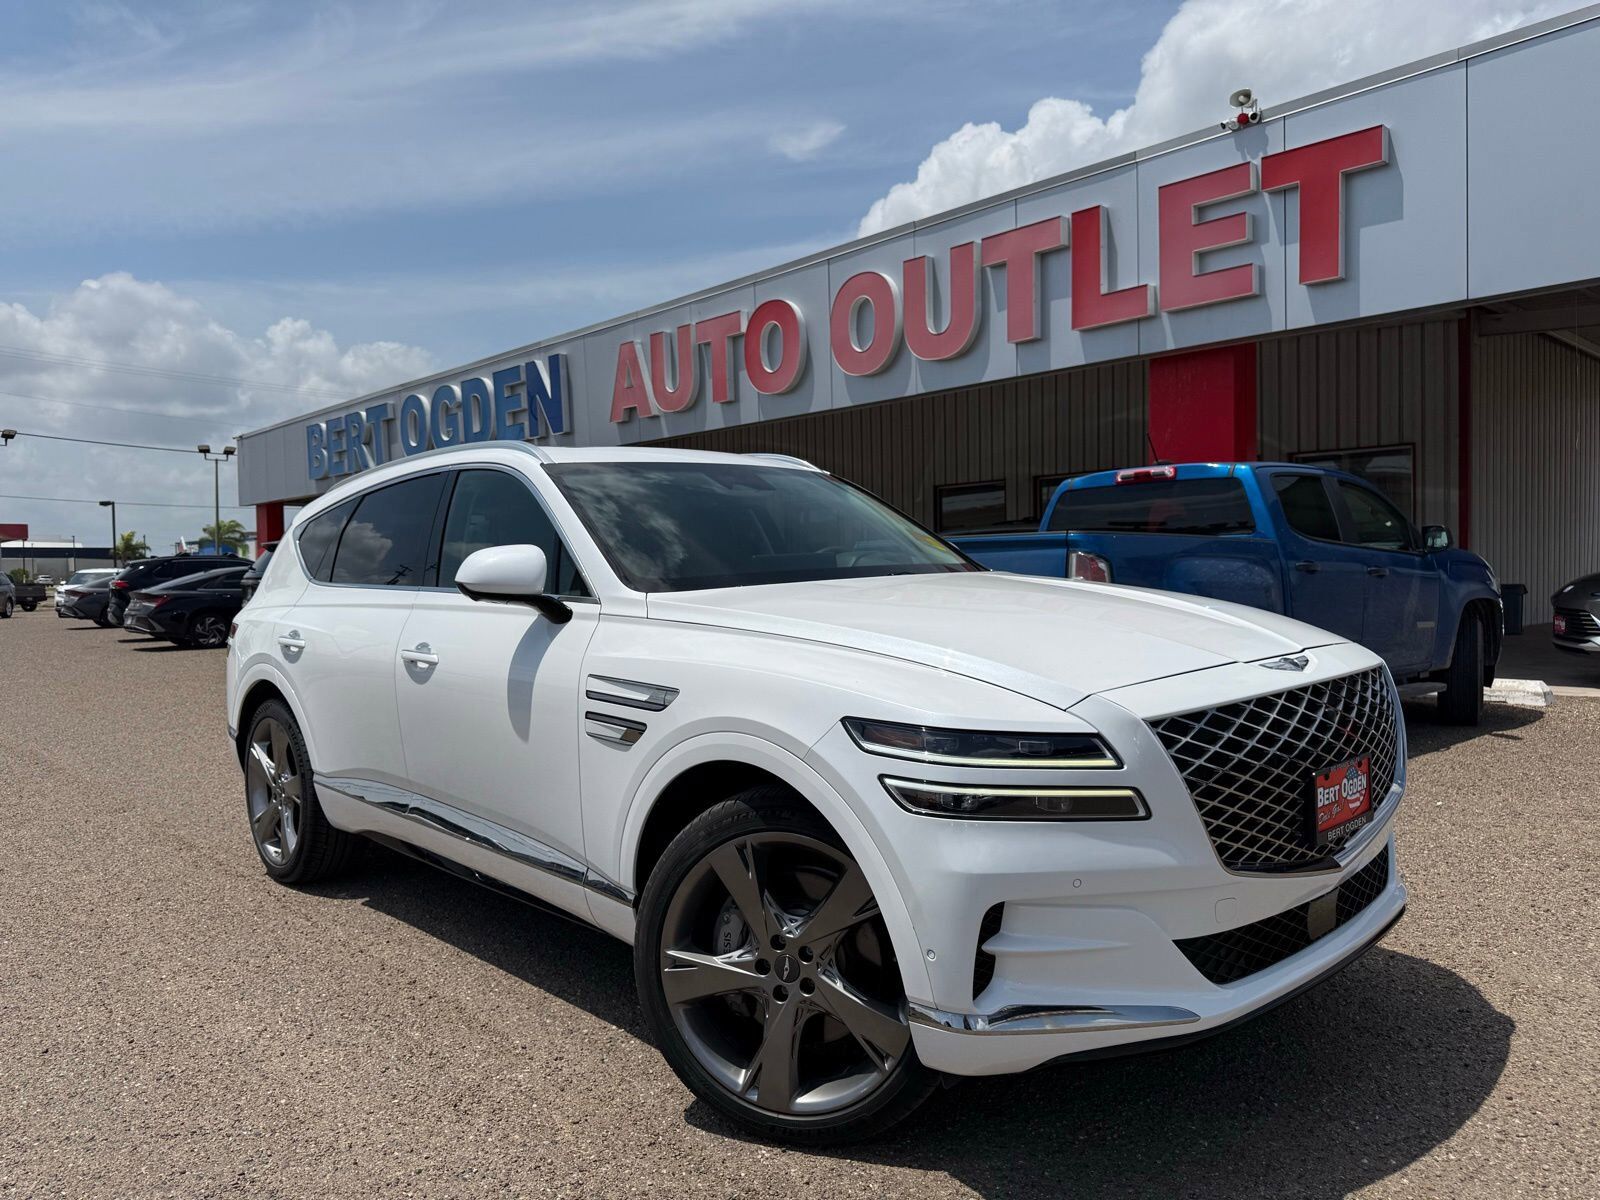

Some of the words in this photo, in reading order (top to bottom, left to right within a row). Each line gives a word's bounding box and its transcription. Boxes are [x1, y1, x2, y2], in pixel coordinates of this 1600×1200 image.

[306, 402, 395, 480] BERT
[400, 353, 574, 457] OGDEN
[609, 298, 808, 424] AUTO
[828, 124, 1390, 377] OUTLET
[1317, 784, 1340, 808] BERT
[1341, 773, 1367, 798] OGDEN
[1327, 825, 1345, 841] BERT
[1345, 815, 1367, 832] OGDEN
